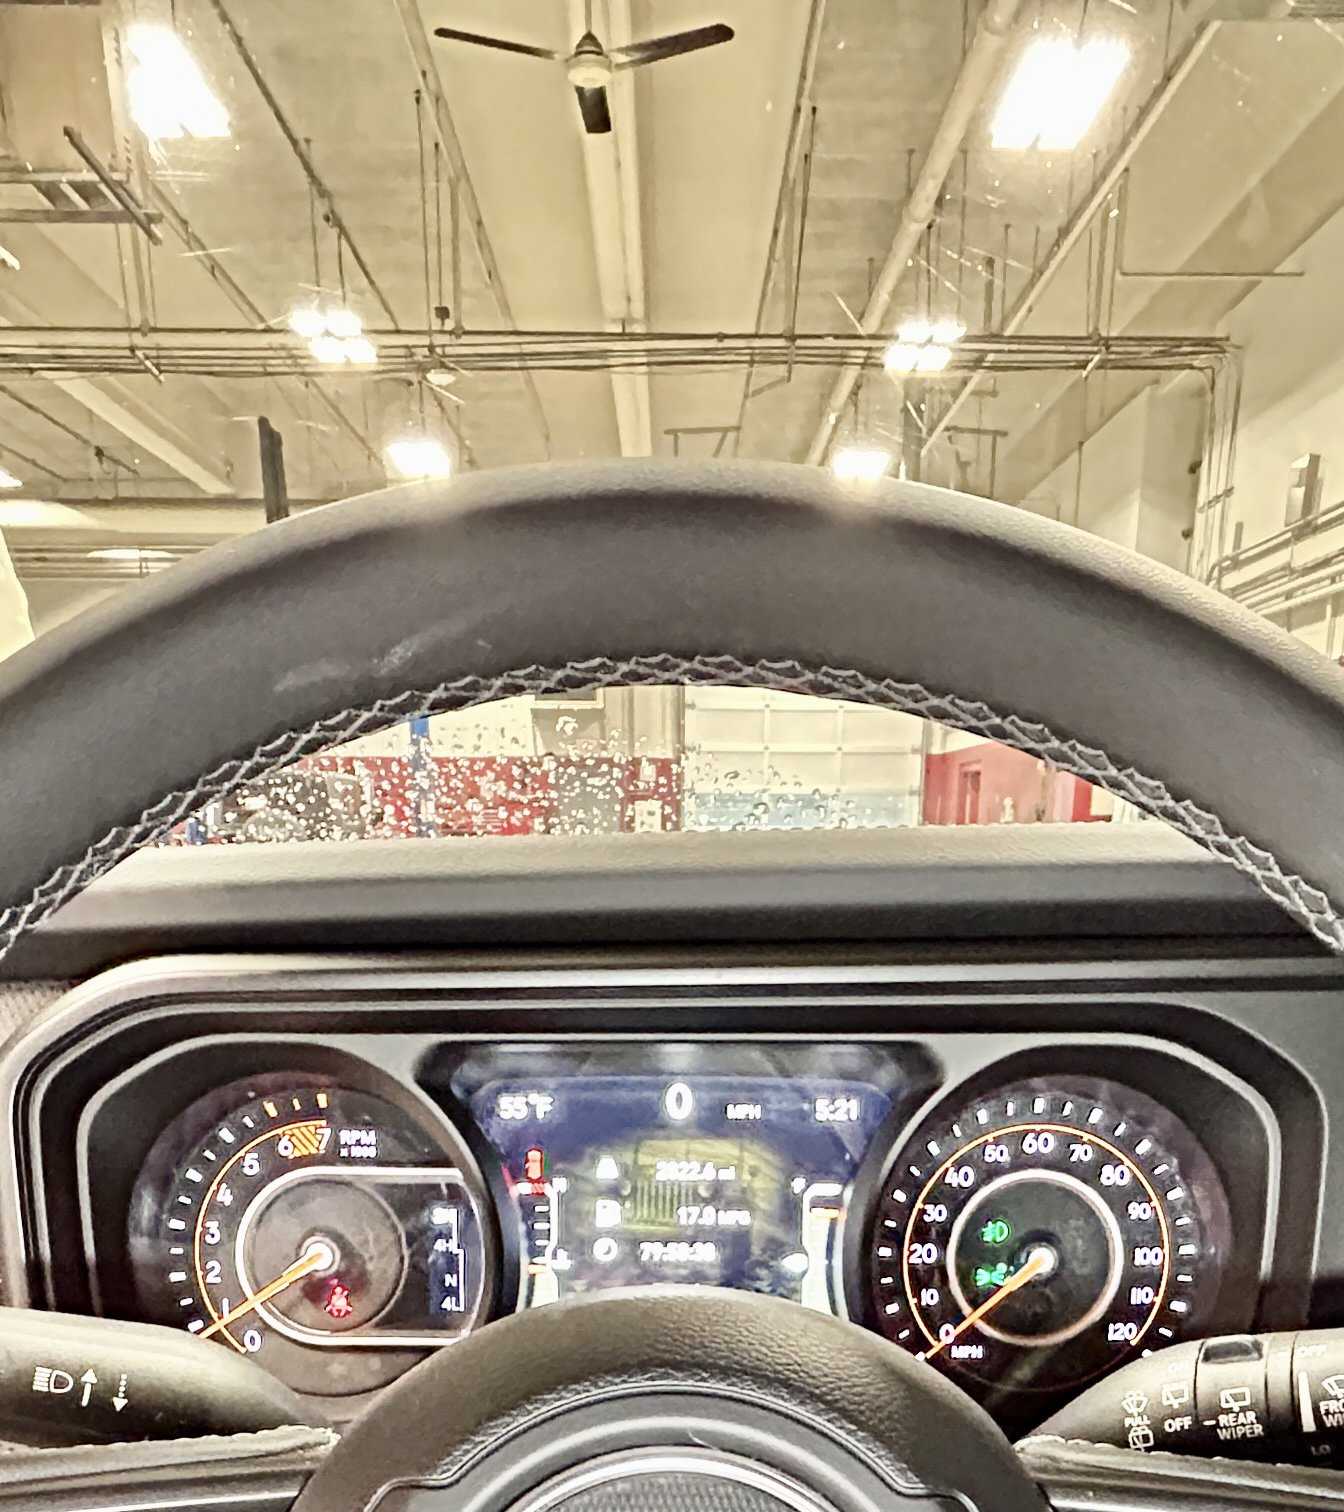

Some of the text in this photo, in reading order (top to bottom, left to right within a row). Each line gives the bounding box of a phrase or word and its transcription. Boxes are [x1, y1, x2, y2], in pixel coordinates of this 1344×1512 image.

[498, 1093, 554, 1120] 55°F
[665, 1081, 694, 1121] 0
[815, 1099, 858, 1121] 5:21
[277, 1135, 294, 1157] 6
[315, 1127, 332, 1150] 7
[339, 1129, 377, 1145] RPM
[1022, 1132, 1055, 1154] 60
[984, 1144, 1009, 1162] 50
[1069, 1144, 1093, 1162] 70
[242, 1152, 260, 1177] 5
[944, 1165, 975, 1188] 40
[1099, 1164, 1130, 1186] 80
[216, 1183, 234, 1207] 4
[923, 1203, 948, 1222] 30
[1127, 1202, 1152, 1221] 90
[204, 1221, 221, 1245] 3
[908, 1243, 938, 1265] 20
[1133, 1246, 1164, 1267] 100
[205, 1260, 222, 1284] 2
[444, 1273, 458, 1287] N
[441, 1296, 460, 1312] 4L
[921, 1288, 940, 1306] 10
[1130, 1287, 1155, 1306] 110
[244, 1328, 262, 1351] 0
[939, 1322, 956, 1344] 0
[1107, 1322, 1138, 1341] 120
[951, 1345, 984, 1359] MPH
[1298, 1344, 1328, 1359] OFF
[1167, 1360, 1190, 1373] ON
[1123, 1415, 1151, 1428] PULL
[1164, 1416, 1192, 1433] OFF
[1218, 1411, 1257, 1427] REAR
[1216, 1424, 1264, 1441] WIPER
